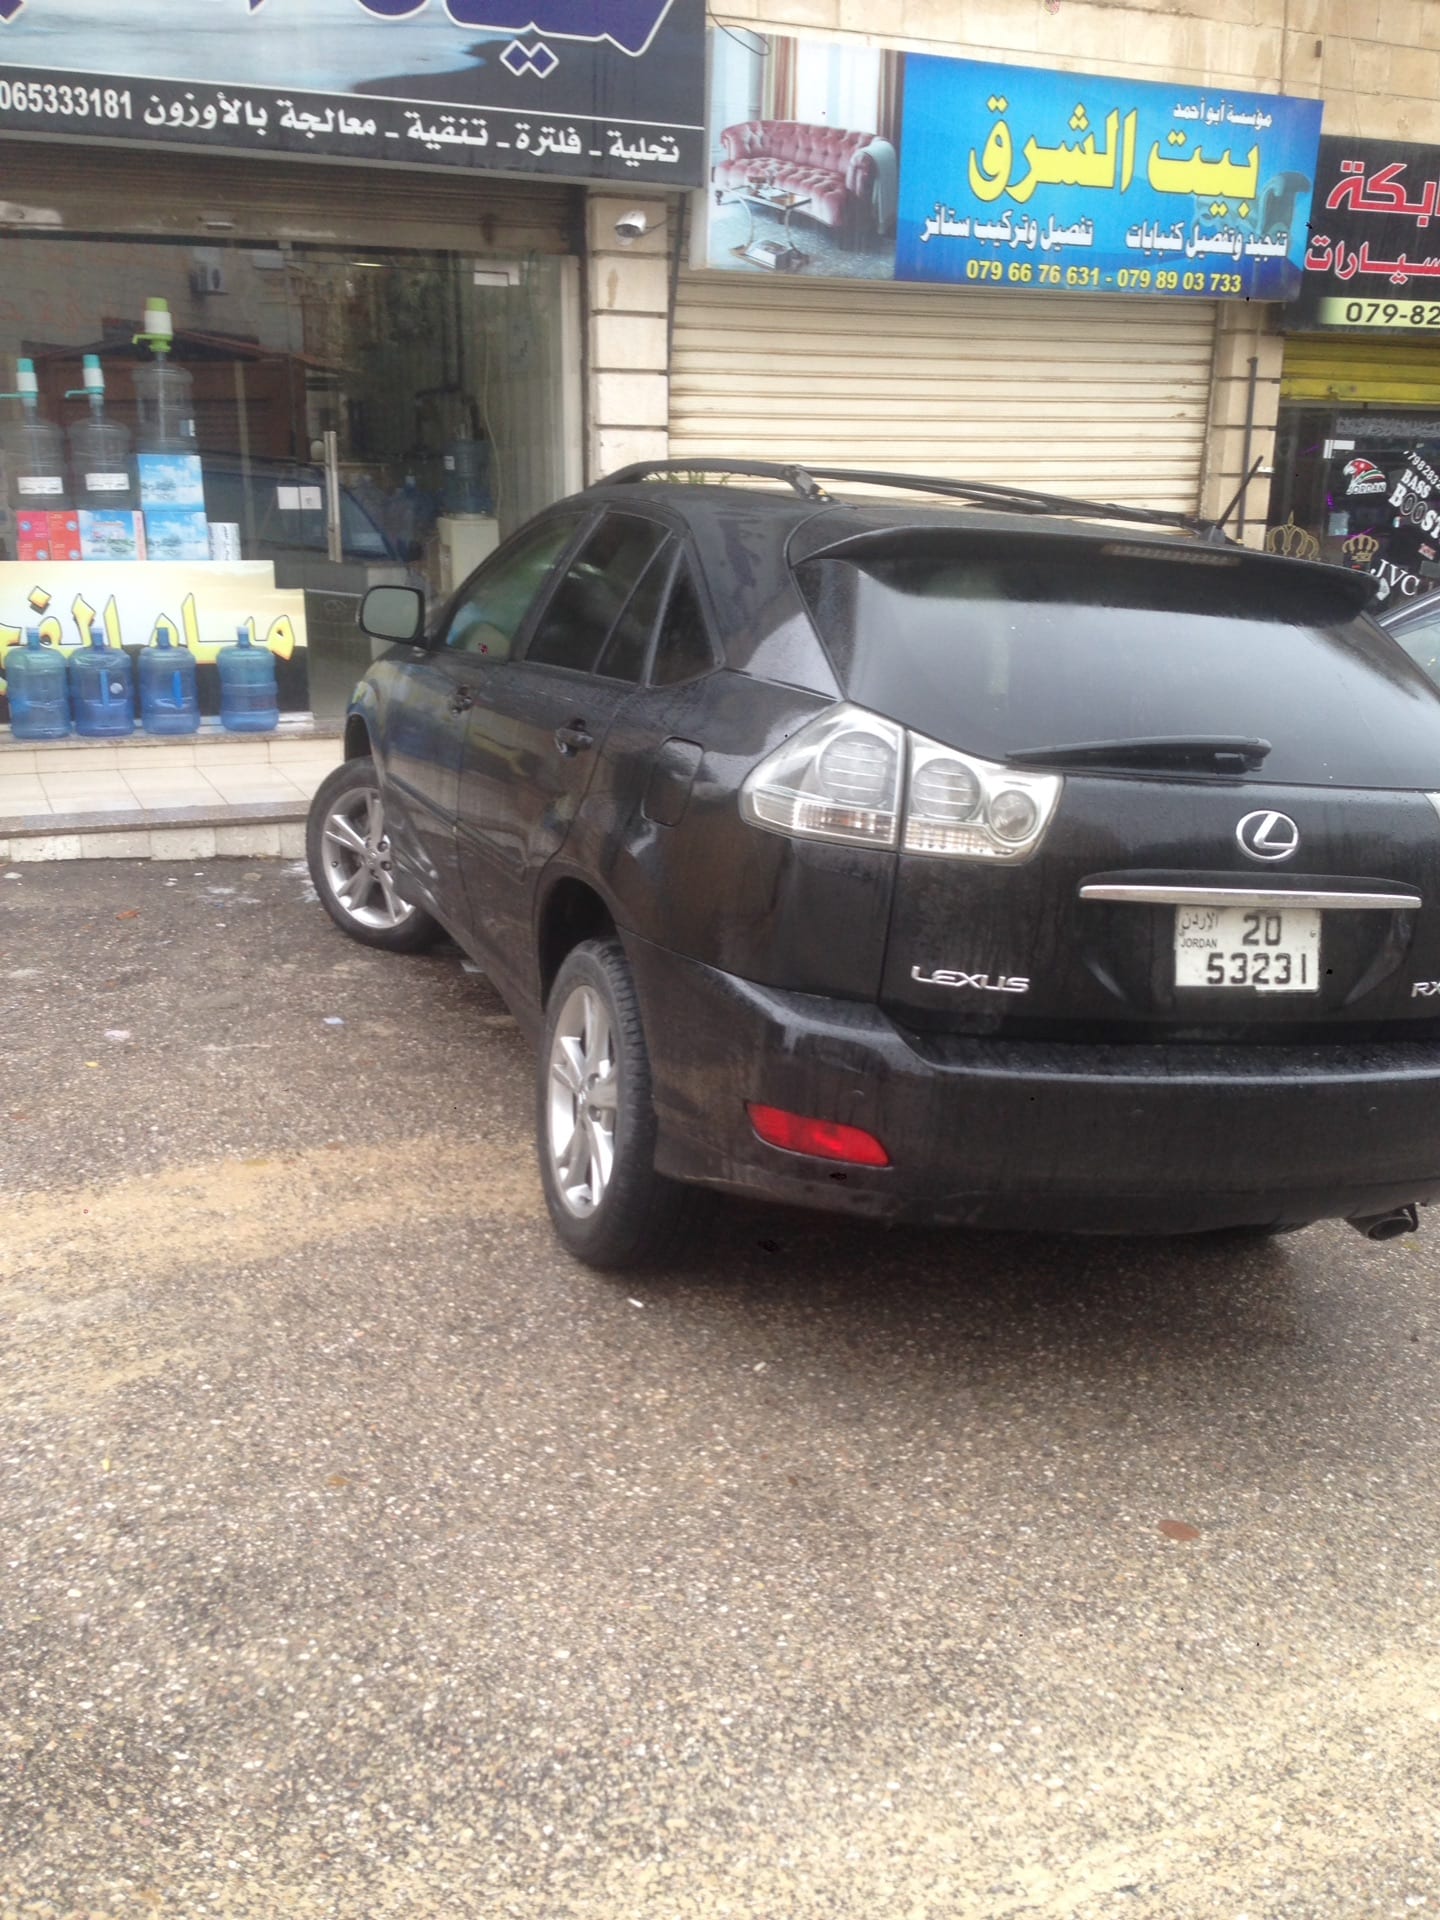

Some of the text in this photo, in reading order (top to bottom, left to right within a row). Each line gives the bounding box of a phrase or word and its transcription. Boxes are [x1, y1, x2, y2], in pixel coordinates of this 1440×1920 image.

[0, 80, 132, 120] 065333181
[1227, 104, 1273, 130] مؤسسة
[276, 98, 377, 139] معالجة
[403, 110, 488, 150] تنقية
[515, 122, 582, 156] فلترة
[607, 130, 680, 167] تحلية
[968, 94, 1260, 219] بيت الشرق
[920, 202, 1094, 251] تفصيل وتركيب ستائر
[1186, 224, 1243, 261] وتفصيل
[1245, 231, 1288, 262] تنجيد
[966, 259, 1003, 281] 079
[1008, 262, 1032, 282] 66
[1038, 264, 1061, 284] 76
[1066, 266, 1100, 286] 631
[1117, 268, 1151, 288] 079
[1155, 270, 1178, 290] 89
[1183, 272, 1205, 291] 03
[1210, 273, 1242, 293] 733
[1345, 302, 1440, 325] 079-82
[1400, 468, 1432, 499] BASS
[1370, 558, 1420, 596] JVC
[1180, 938, 1217, 948] JORDAN
[1242, 913, 1282, 946] 20
[911, 965, 1030, 993] LEXUS
[1206, 952, 1307, 985] 53231
